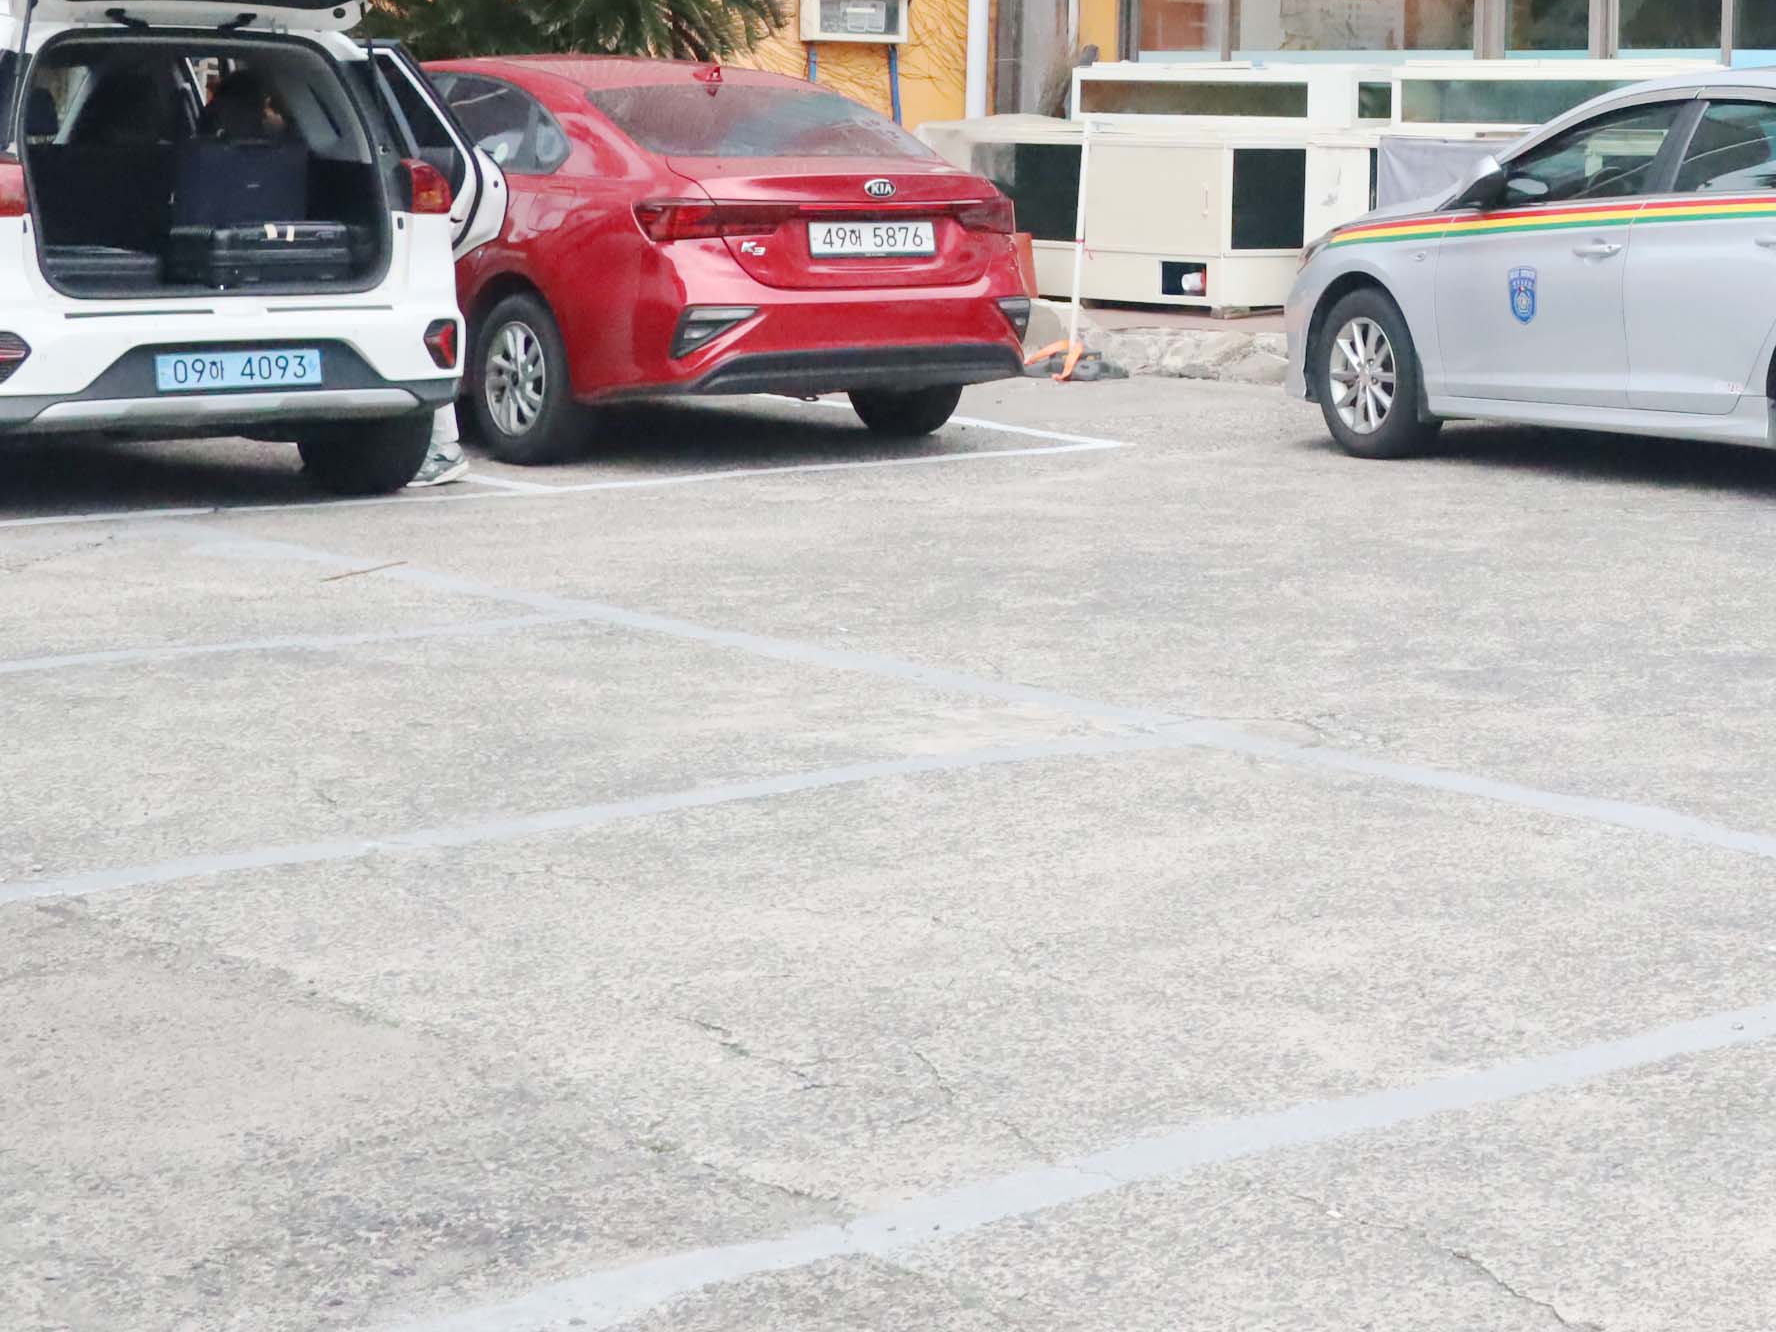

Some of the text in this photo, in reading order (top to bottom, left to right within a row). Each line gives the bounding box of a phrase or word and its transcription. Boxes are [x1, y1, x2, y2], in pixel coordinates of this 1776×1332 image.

[868, 182, 894, 195] KIA
[872, 226, 924, 248] 5876
[239, 354, 308, 382] 4093
